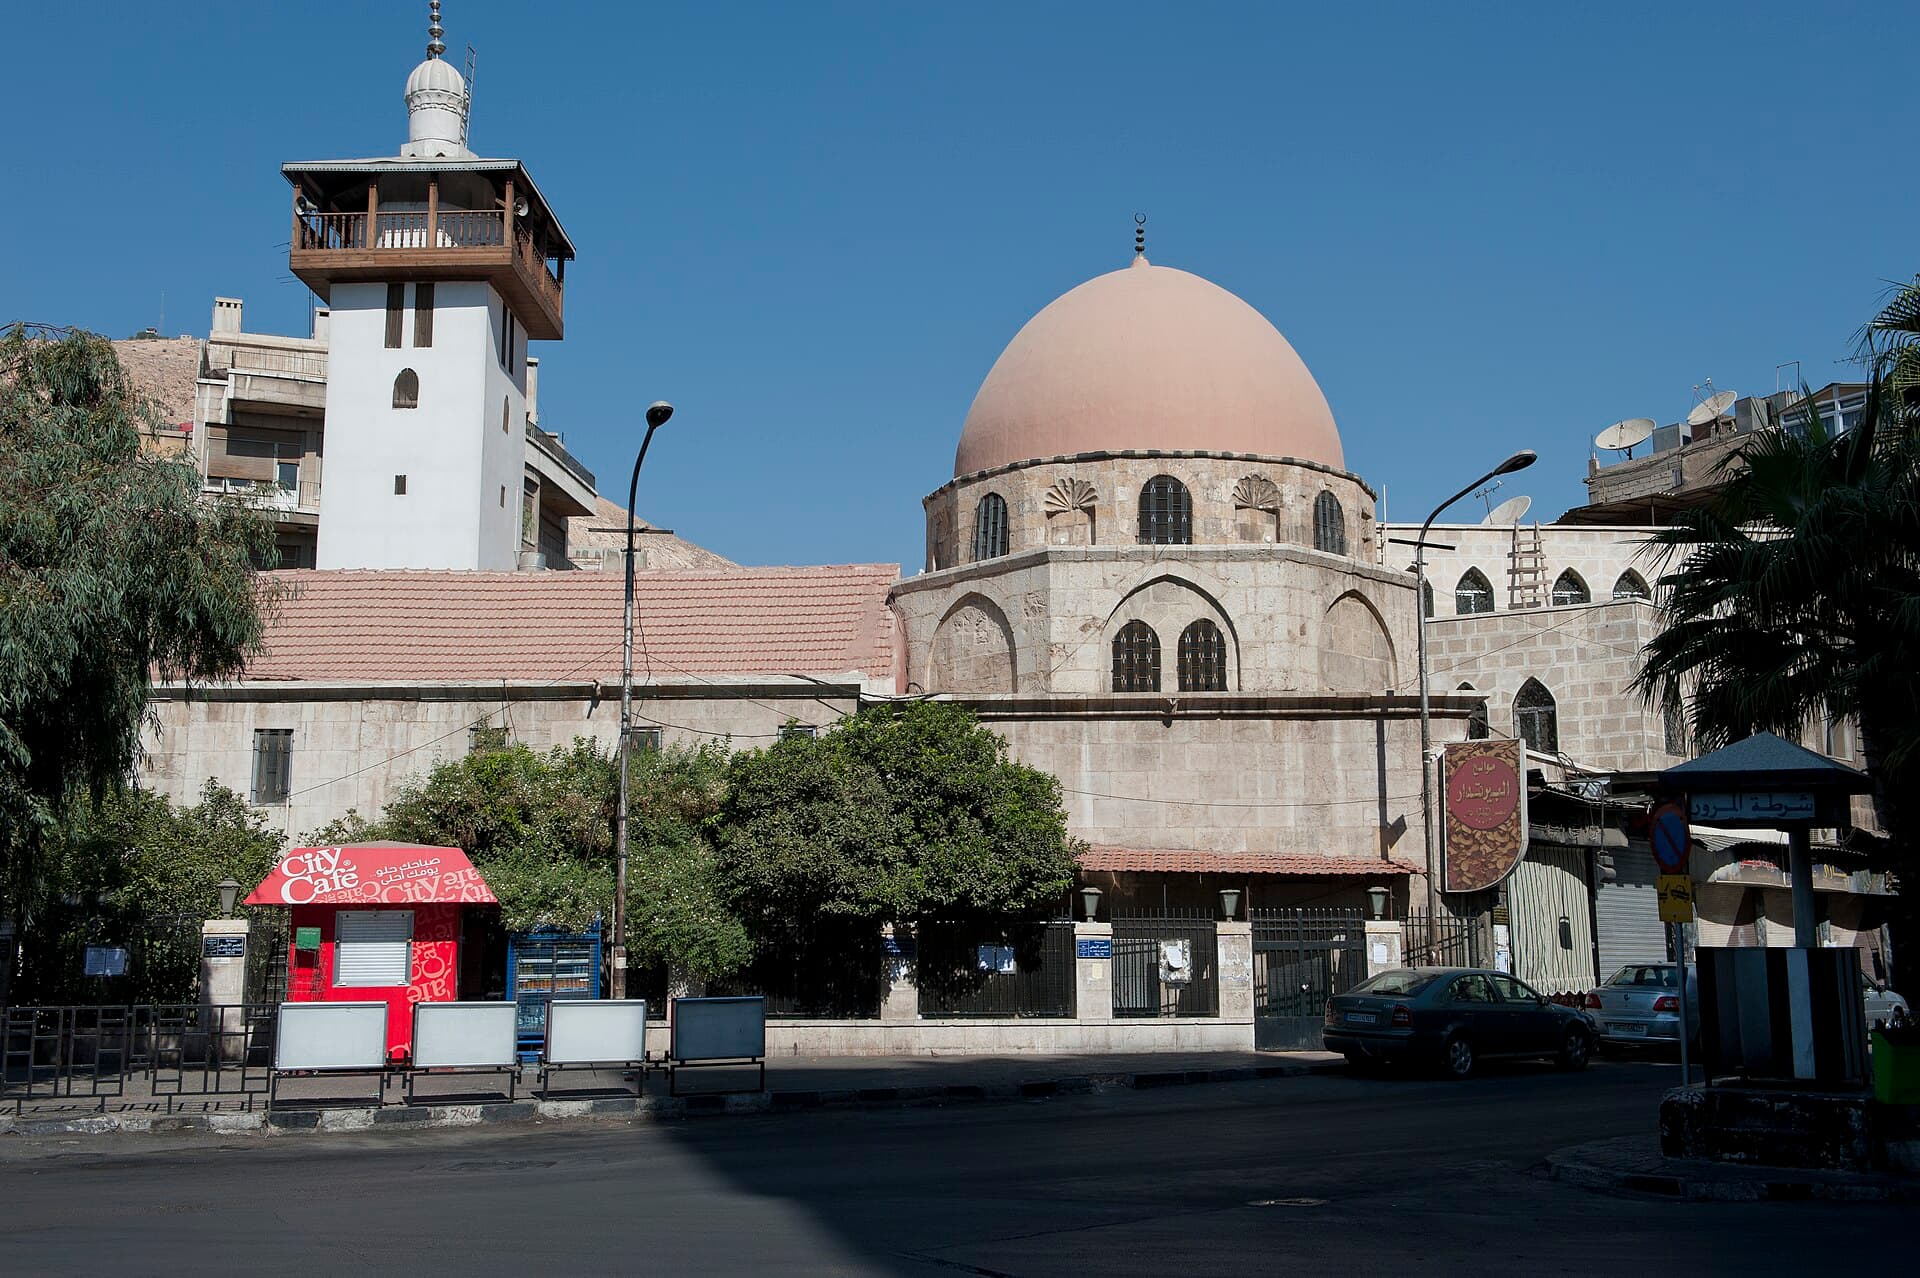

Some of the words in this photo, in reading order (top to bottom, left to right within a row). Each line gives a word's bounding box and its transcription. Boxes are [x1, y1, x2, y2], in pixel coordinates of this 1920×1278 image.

[1690, 793, 1743, 818] المرور
[1749, 793, 1814, 817] شرطة
[281, 848, 342, 877] City
[375, 866, 398, 878] حلو
[399, 857, 441, 872] صباحك
[406, 867, 439, 879] يومك
[280, 864, 359, 903] Café
[442, 867, 479, 893] afé
